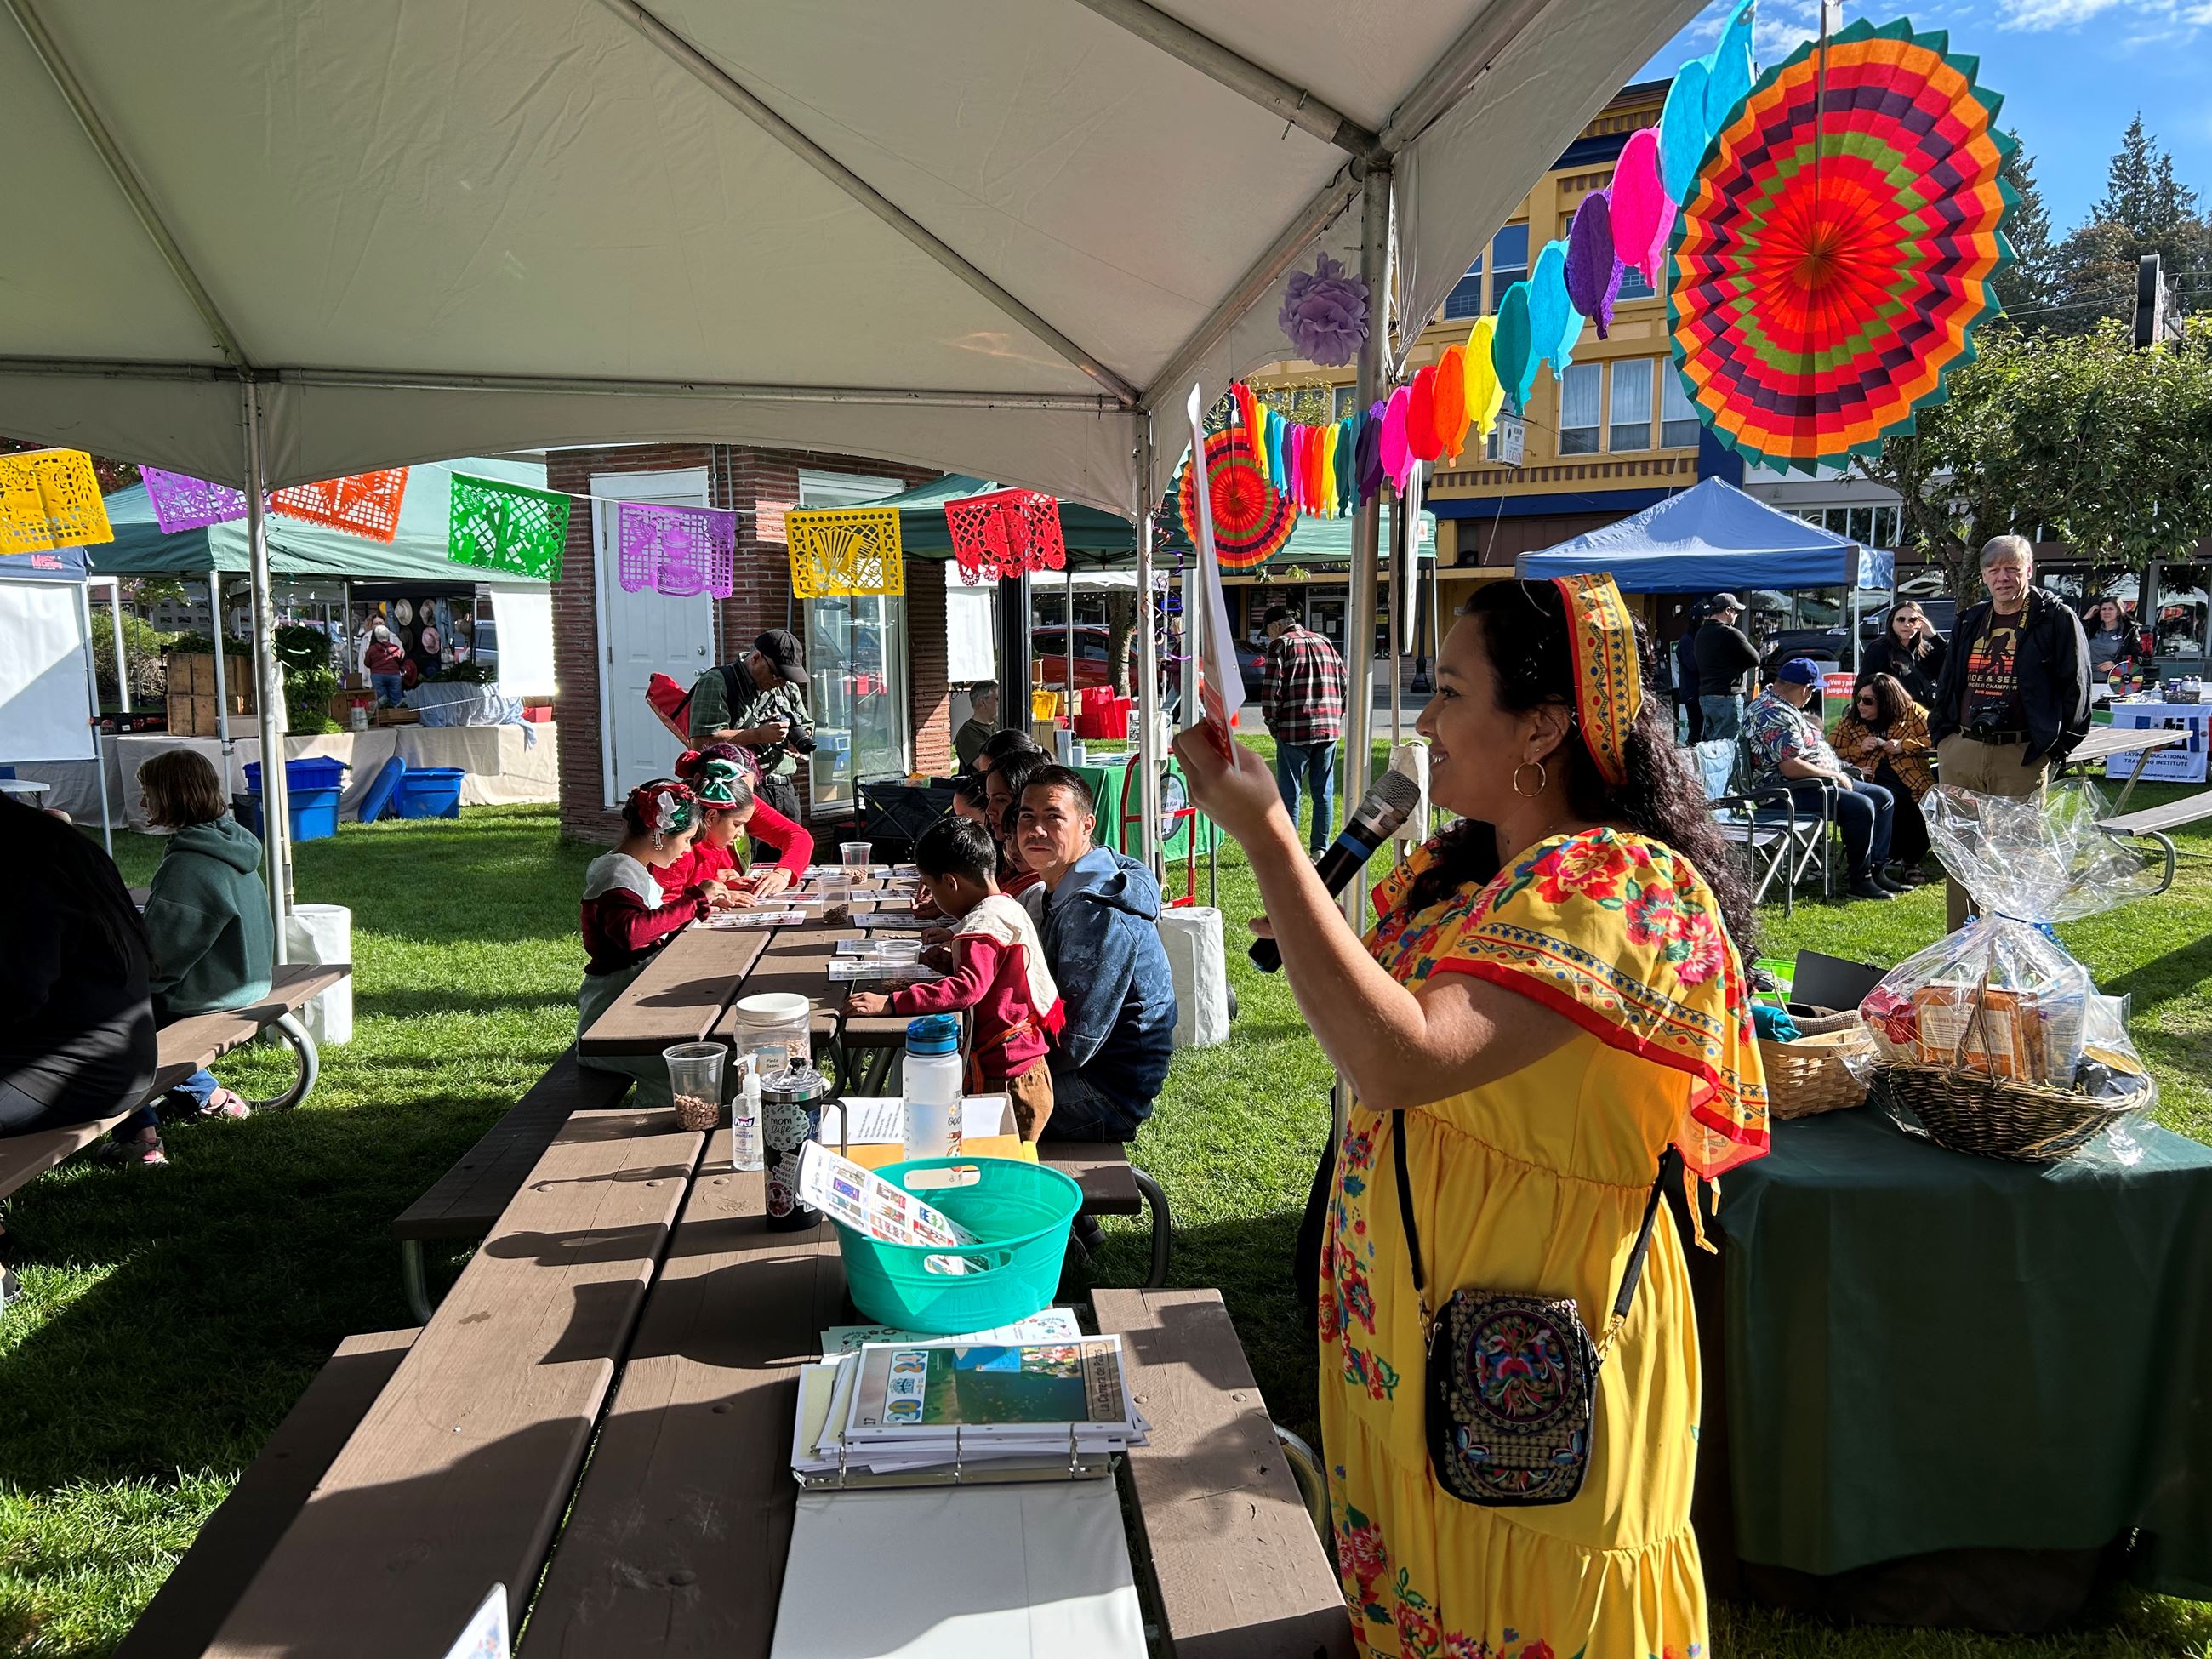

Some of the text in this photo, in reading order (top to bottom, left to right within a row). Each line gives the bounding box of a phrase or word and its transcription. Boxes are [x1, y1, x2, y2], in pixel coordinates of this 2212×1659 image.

[772, 1125, 793, 1135] life
[1094, 1348, 1109, 1411] La Carrera de Patos
